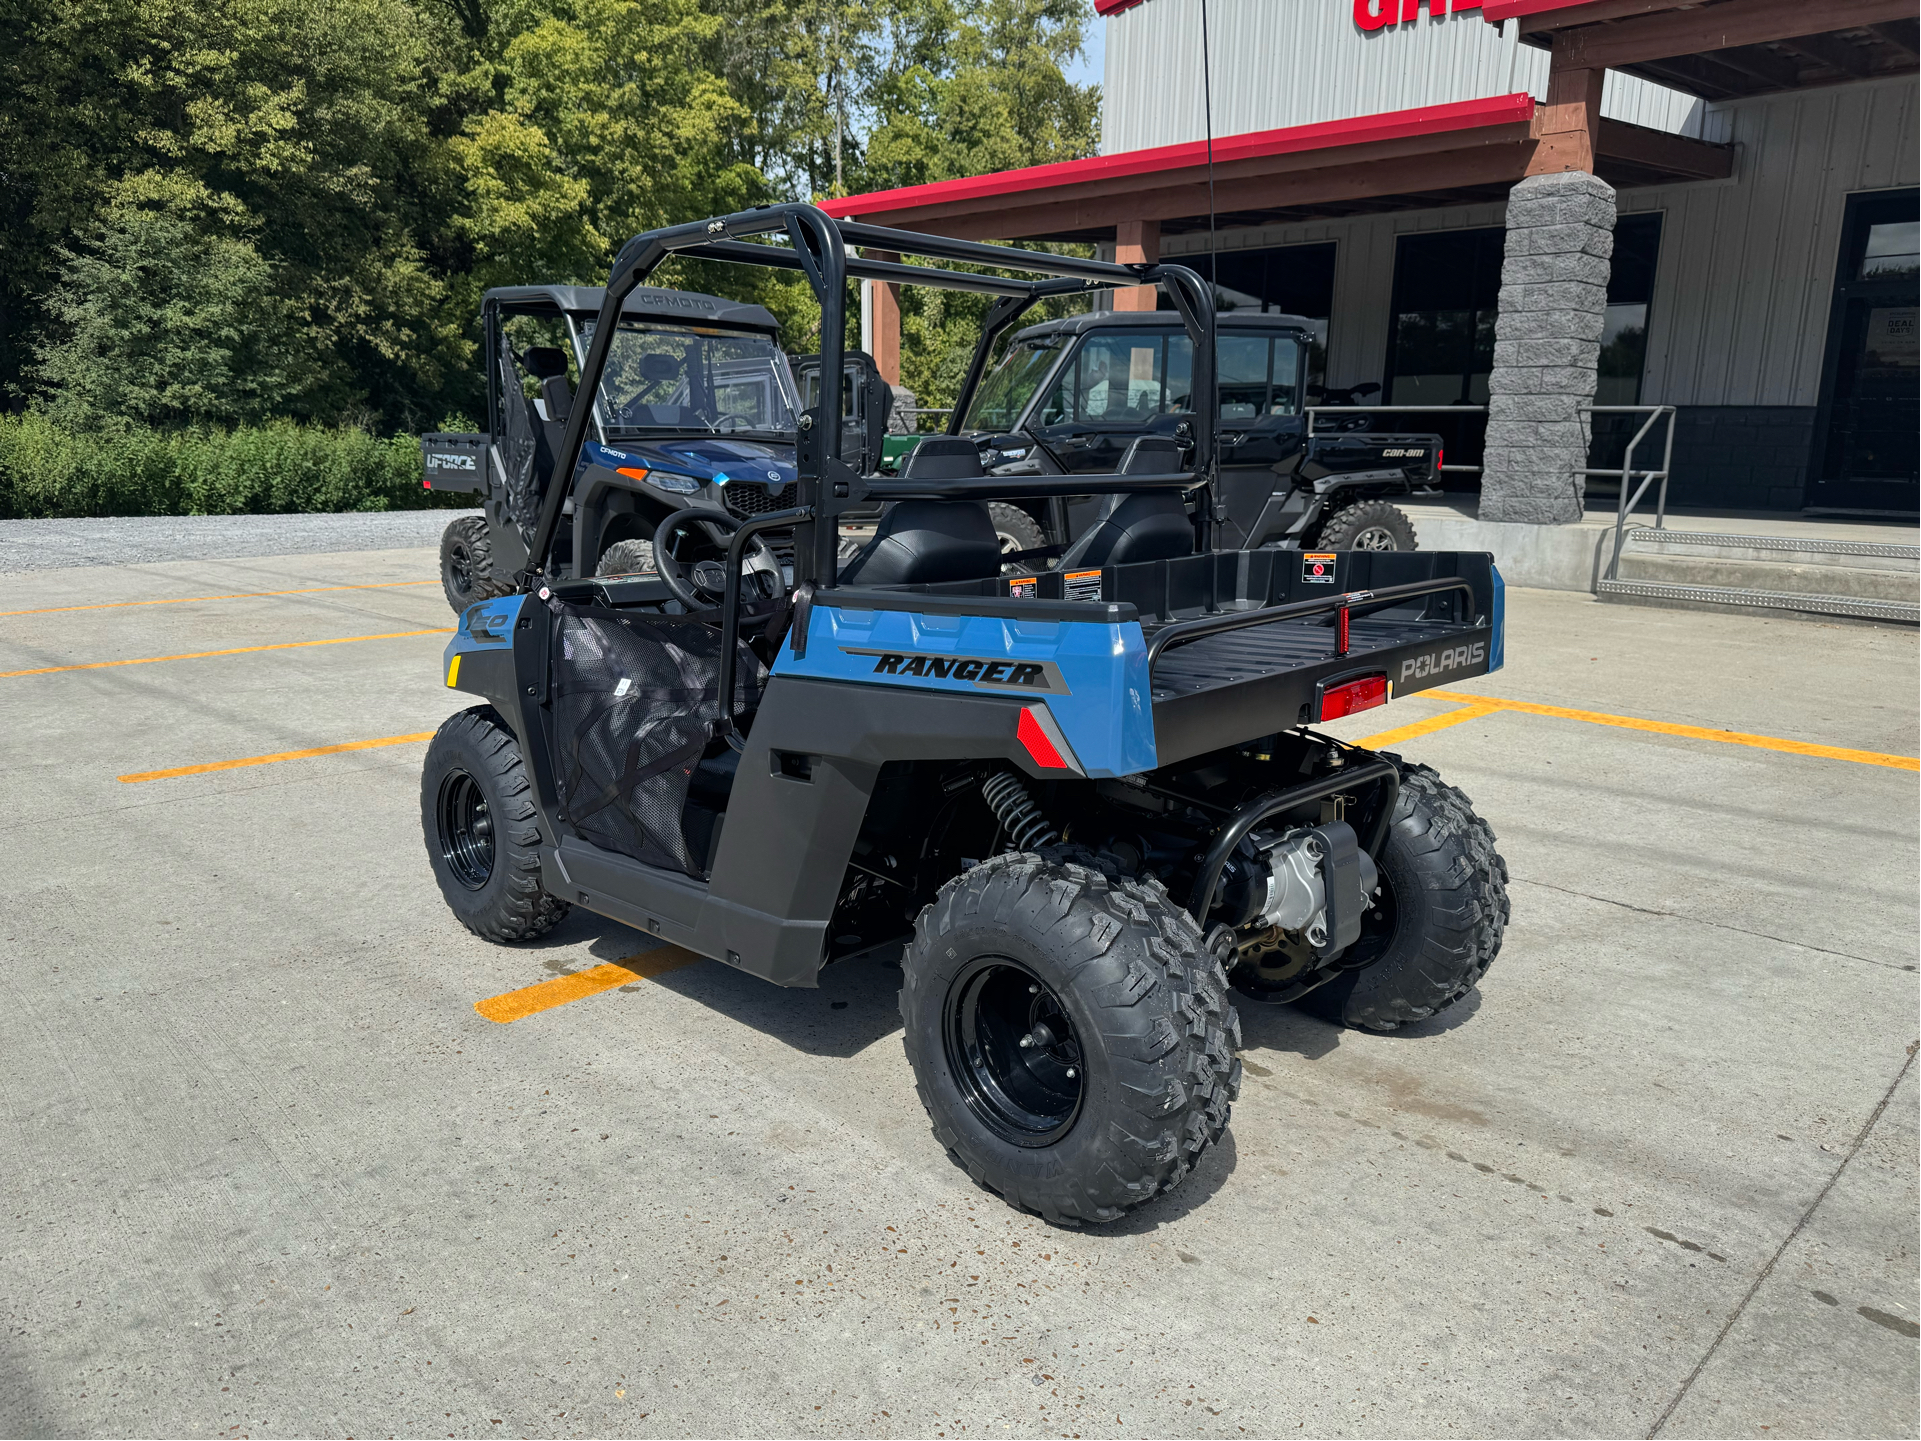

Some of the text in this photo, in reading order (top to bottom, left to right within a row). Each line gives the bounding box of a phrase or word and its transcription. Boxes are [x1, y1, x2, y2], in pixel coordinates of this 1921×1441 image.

[641, 294, 716, 311] CFMOTO
[600, 446, 627, 460] CFMOTO
[1382, 448, 1425, 457] can-am
[426, 453, 477, 471] UFORCE
[872, 653, 1044, 685] RANGER
[1400, 641, 1486, 683] POLARIS
[969, 1129, 1066, 1180] WANDA
